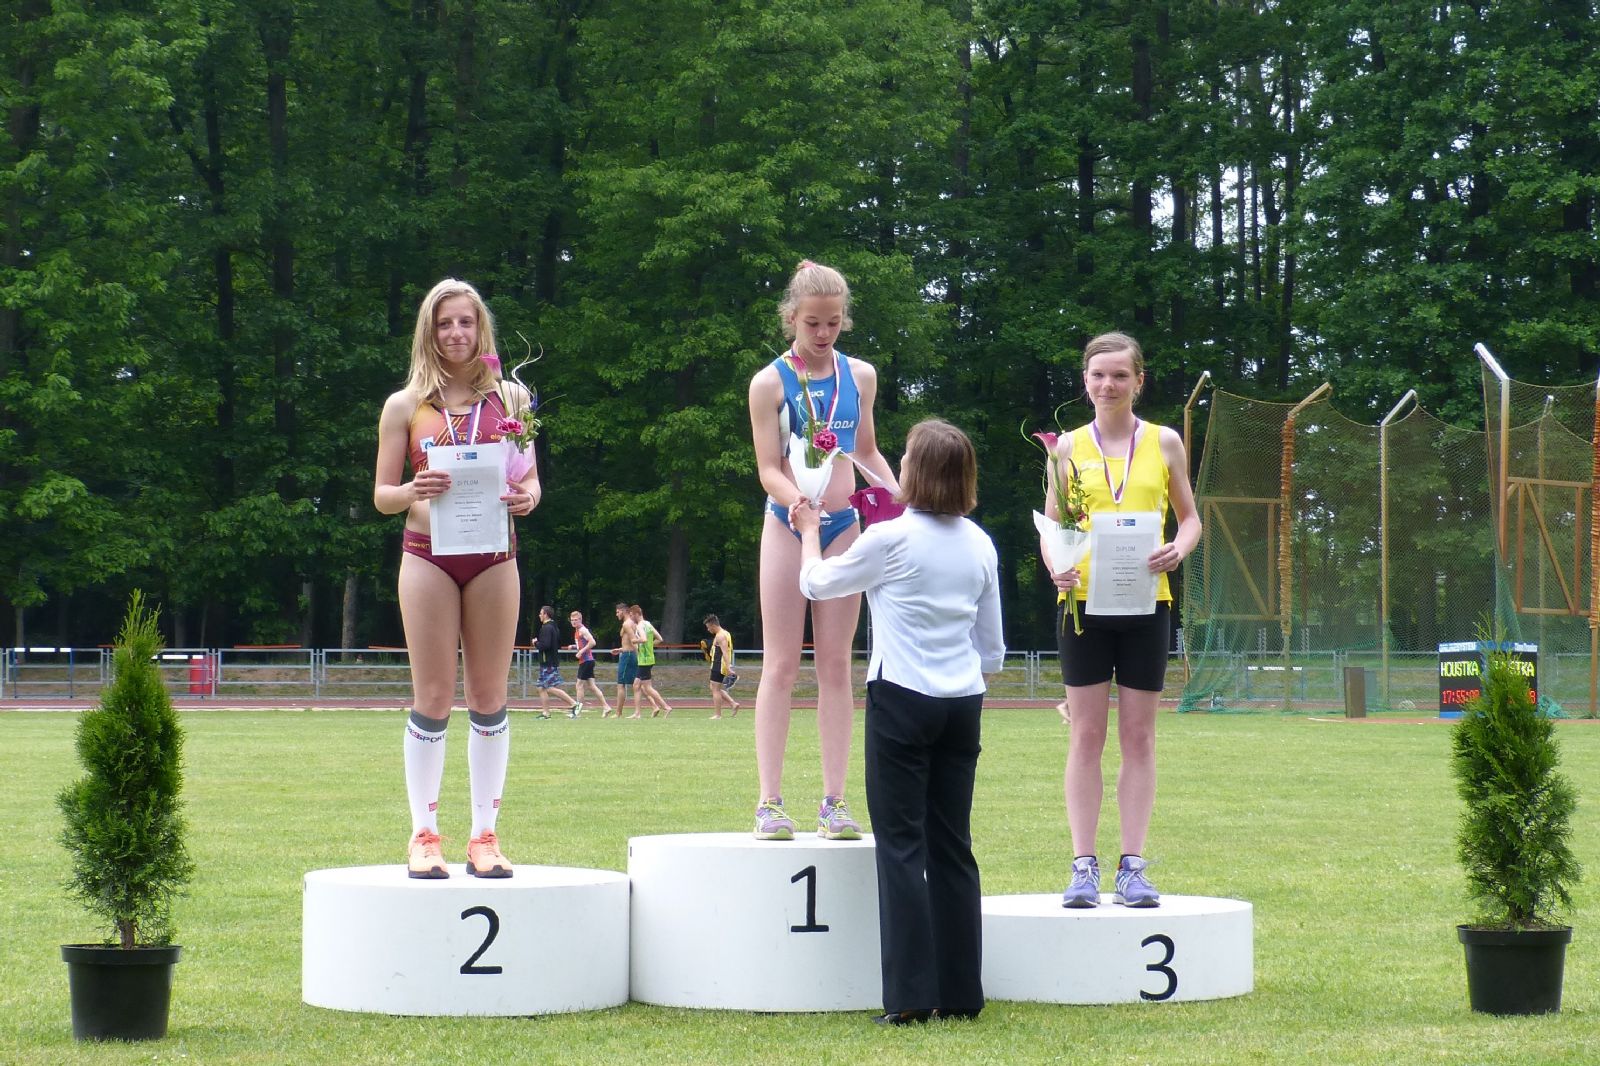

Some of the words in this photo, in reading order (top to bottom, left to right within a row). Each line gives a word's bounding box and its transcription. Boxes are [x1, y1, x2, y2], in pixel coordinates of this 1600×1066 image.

[1440, 661, 1480, 677] HOUSTKA
[790, 865, 830, 933] 1
[459, 905, 503, 975] 2
[1139, 933, 1178, 1002] 3
